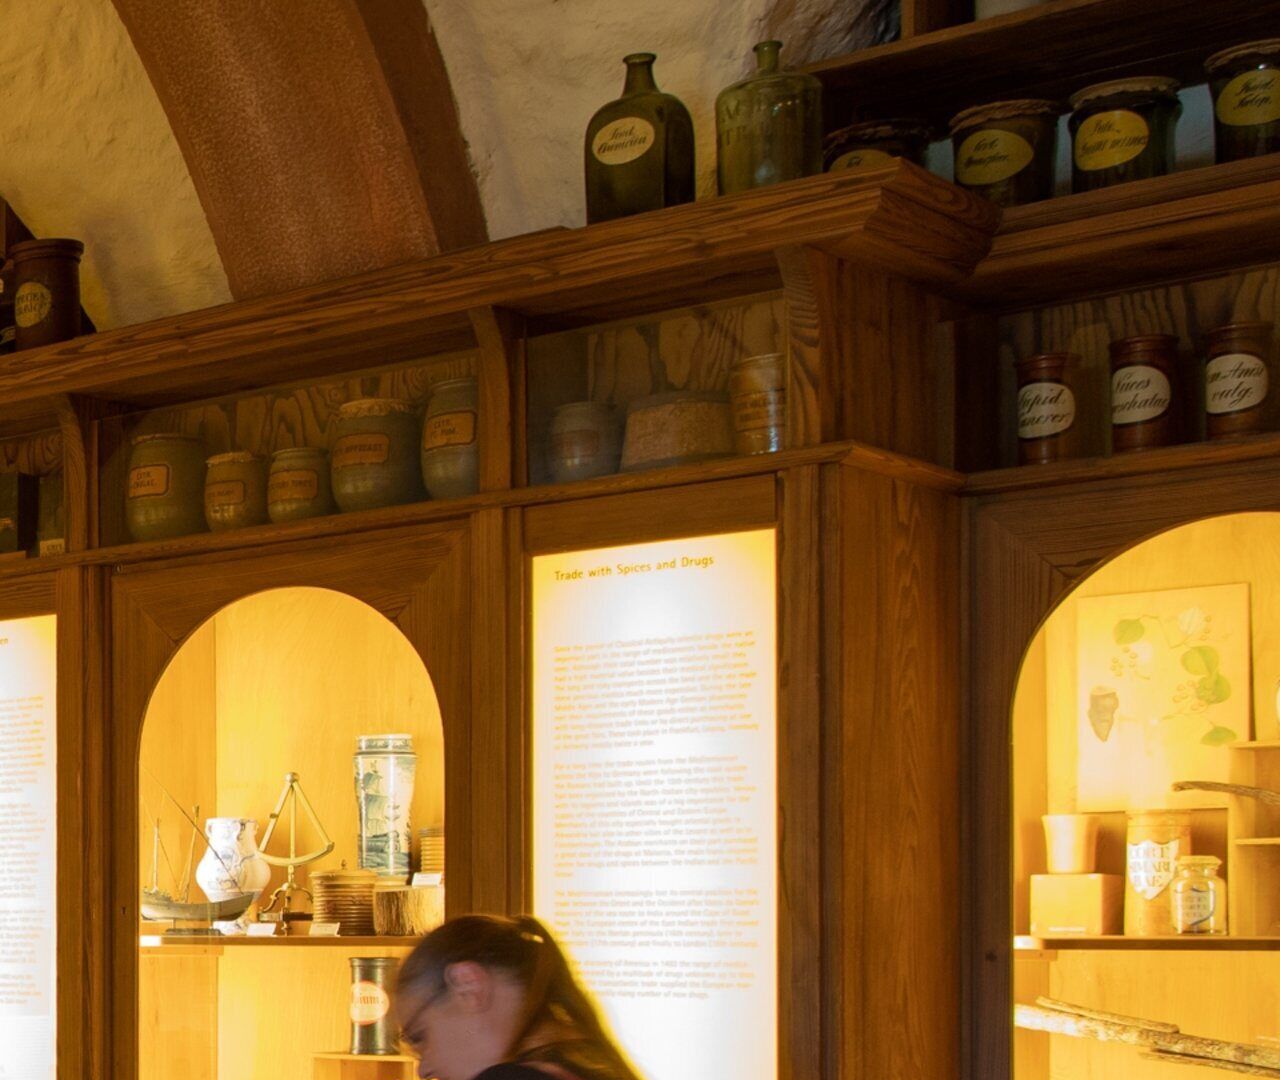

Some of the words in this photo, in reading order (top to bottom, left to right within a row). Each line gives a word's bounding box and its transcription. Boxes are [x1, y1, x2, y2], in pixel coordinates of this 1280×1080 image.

[554, 569, 584, 581] Trade
[587, 566, 612, 577] with
[616, 562, 652, 576] Spices
[656, 557, 676, 570] and
[681, 555, 715, 569] Drugs
